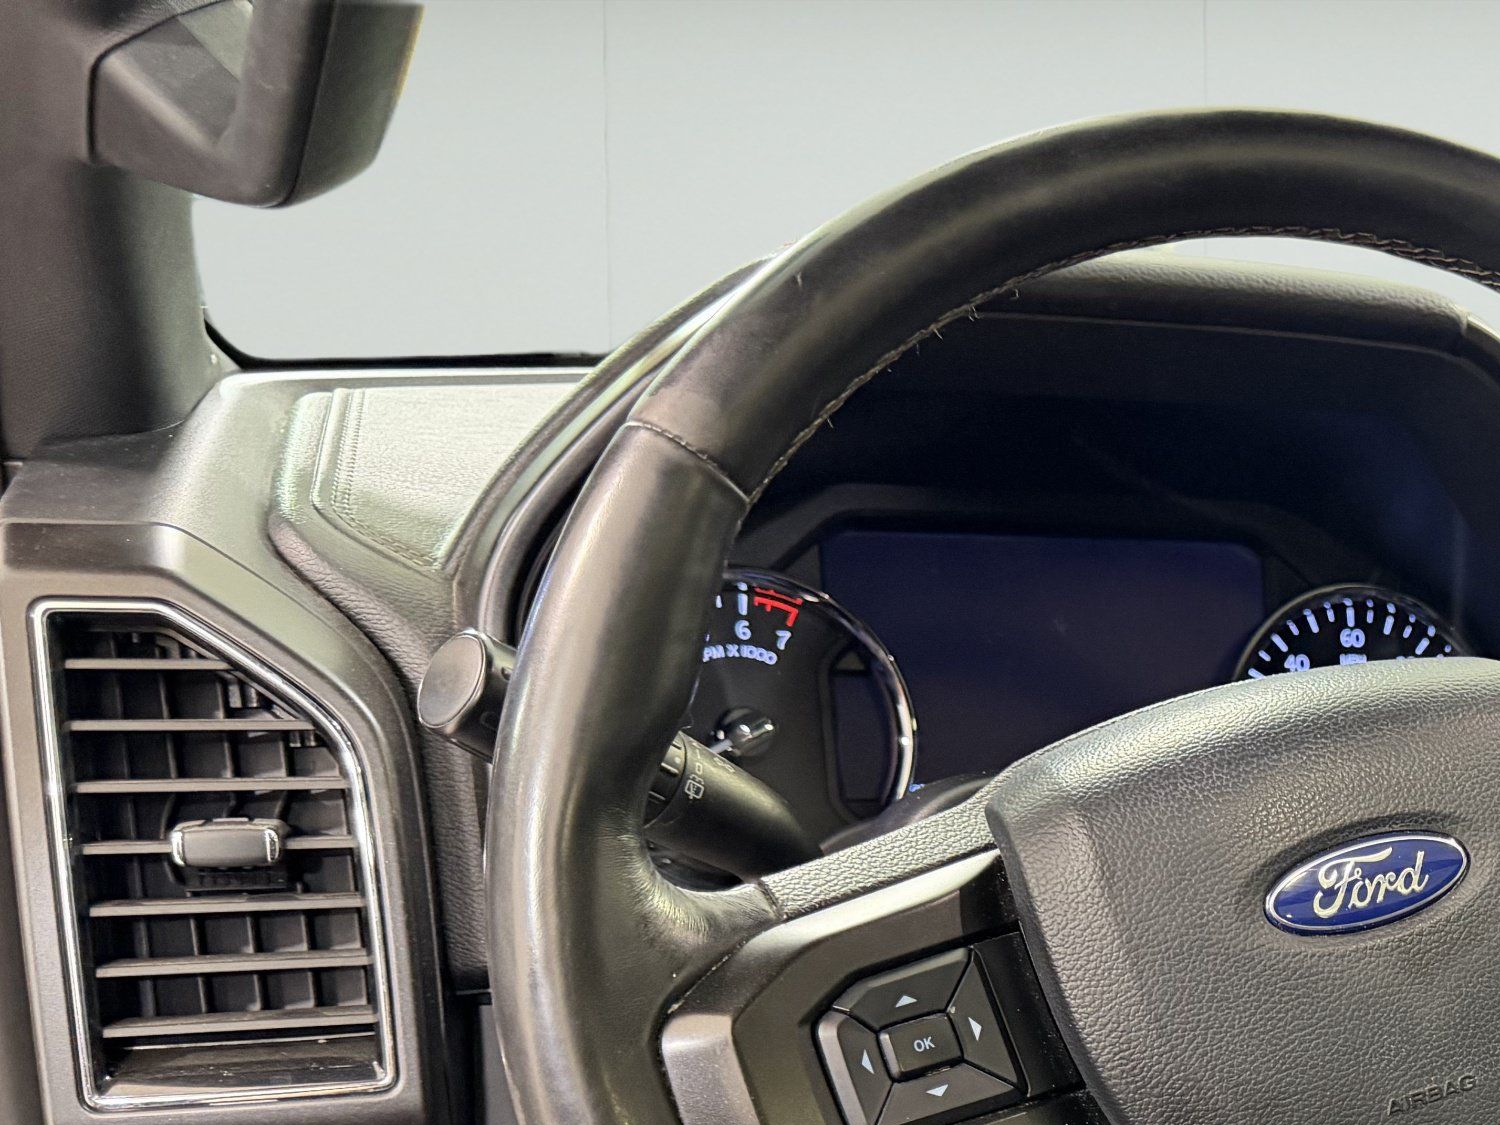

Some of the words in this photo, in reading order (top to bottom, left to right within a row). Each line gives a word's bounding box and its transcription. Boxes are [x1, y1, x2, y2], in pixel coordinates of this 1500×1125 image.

[735, 620, 751, 640] 6
[776, 630, 792, 650] 7
[1340, 628, 1366, 648] 60
[702, 645, 726, 662] PM
[1284, 654, 1311, 672] 40
[1313, 846, 1430, 919] Ford
[913, 1036, 936, 1053] OK
[1387, 1074, 1476, 1117] AIRBAG
